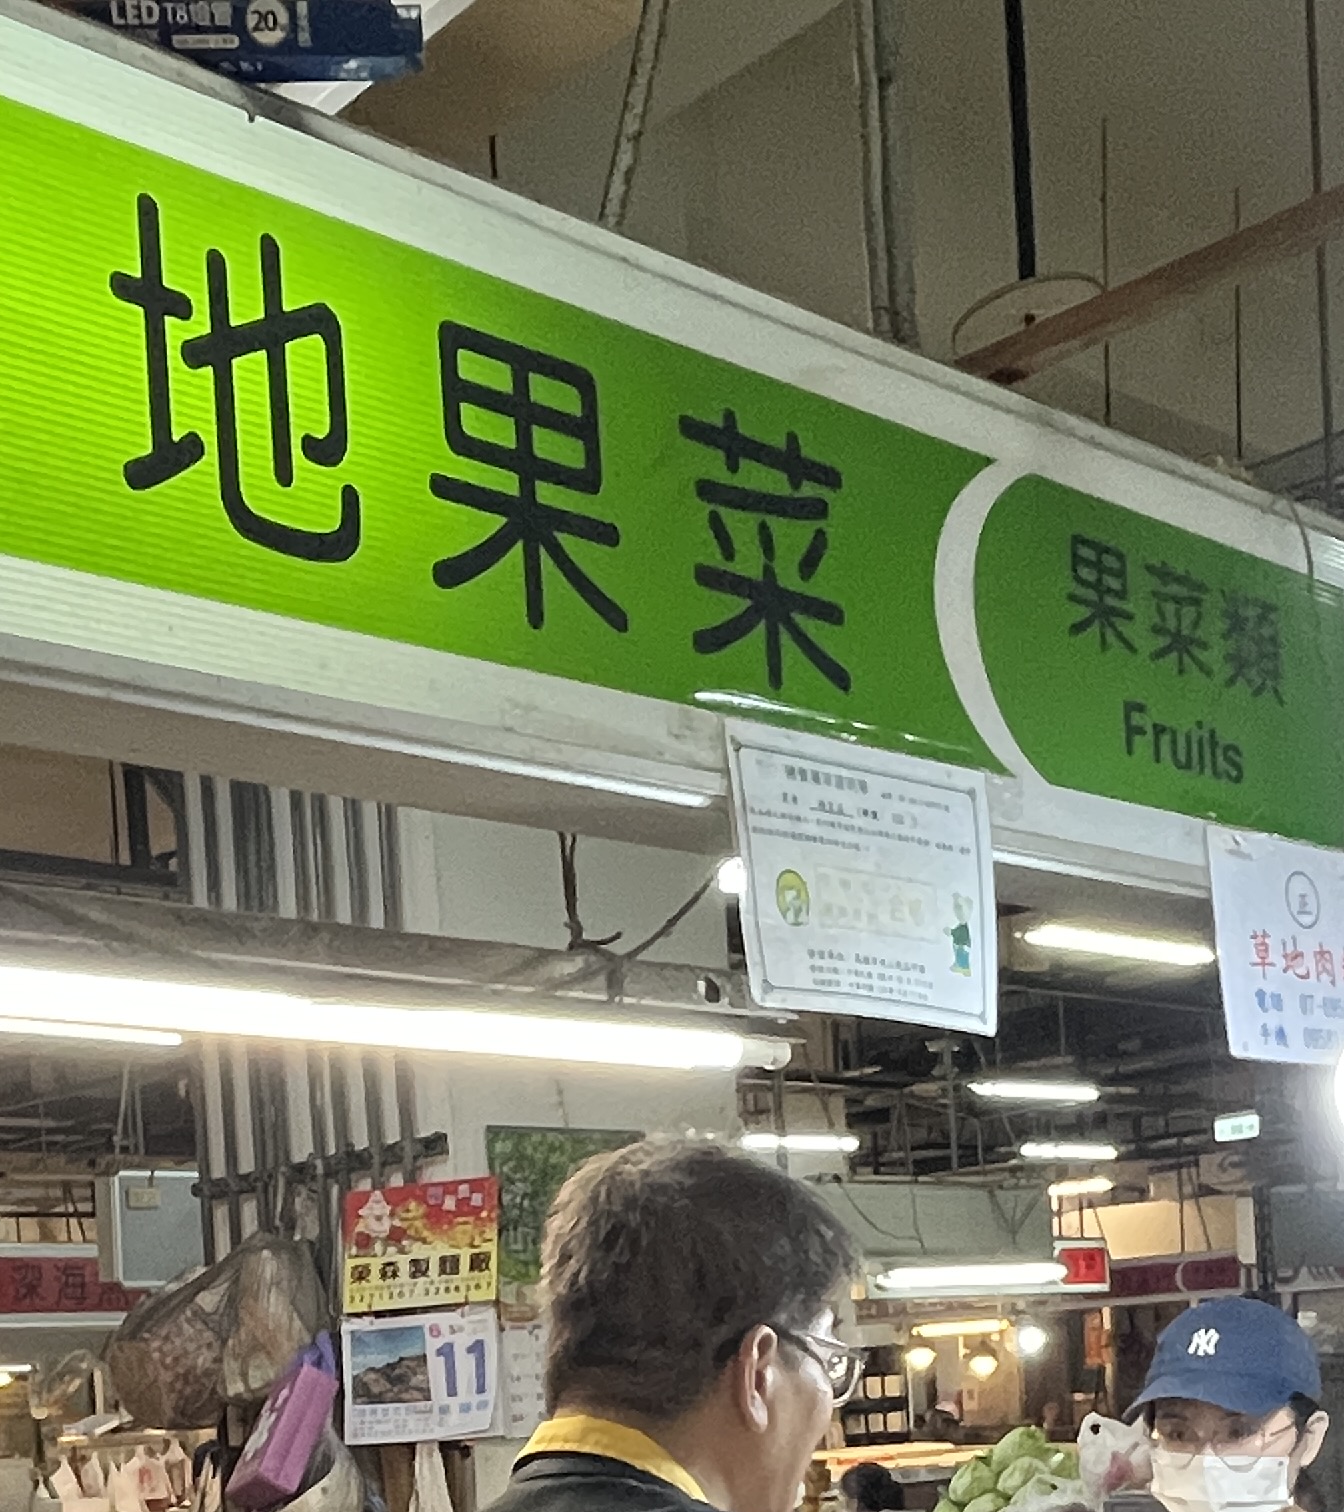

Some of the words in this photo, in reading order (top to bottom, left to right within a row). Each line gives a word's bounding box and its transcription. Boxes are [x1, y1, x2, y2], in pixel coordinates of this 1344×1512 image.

[1066, 533, 1287, 708] 果菜類
[1123, 700, 1244, 784] Fruits
[435, 1338, 487, 1398] 11
